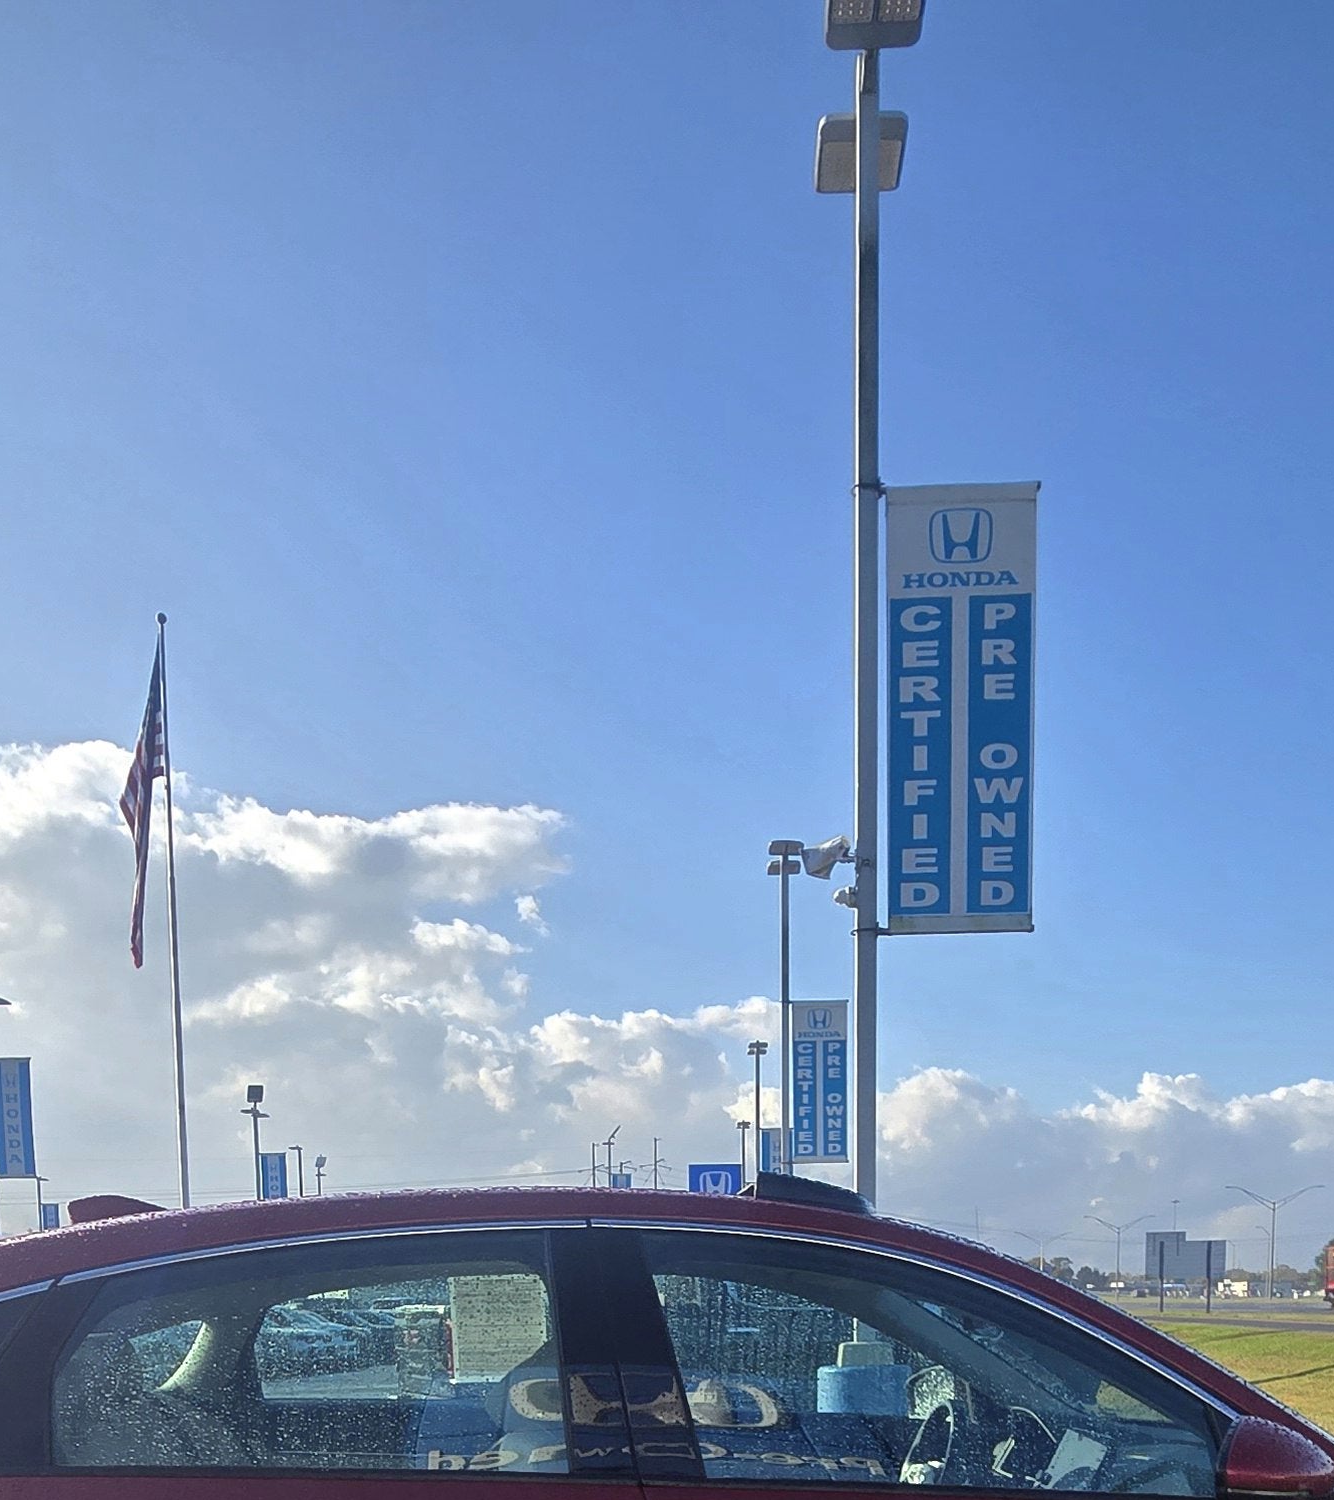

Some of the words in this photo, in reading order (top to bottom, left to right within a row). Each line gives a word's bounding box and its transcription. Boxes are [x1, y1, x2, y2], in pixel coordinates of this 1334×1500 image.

[901, 570, 1019, 590] HONDA
[981, 602, 1017, 700] PRE
[898, 604, 942, 908] CERTIFIED
[973, 743, 1024, 907] OWNED
[797, 1030, 841, 1038] HONDA
[827, 1042, 841, 1078] PRE
[5, 1093, 23, 1164] HONDA
[797, 1043, 814, 1154] CERTIFIED
[826, 1093, 844, 1153] OWNED
